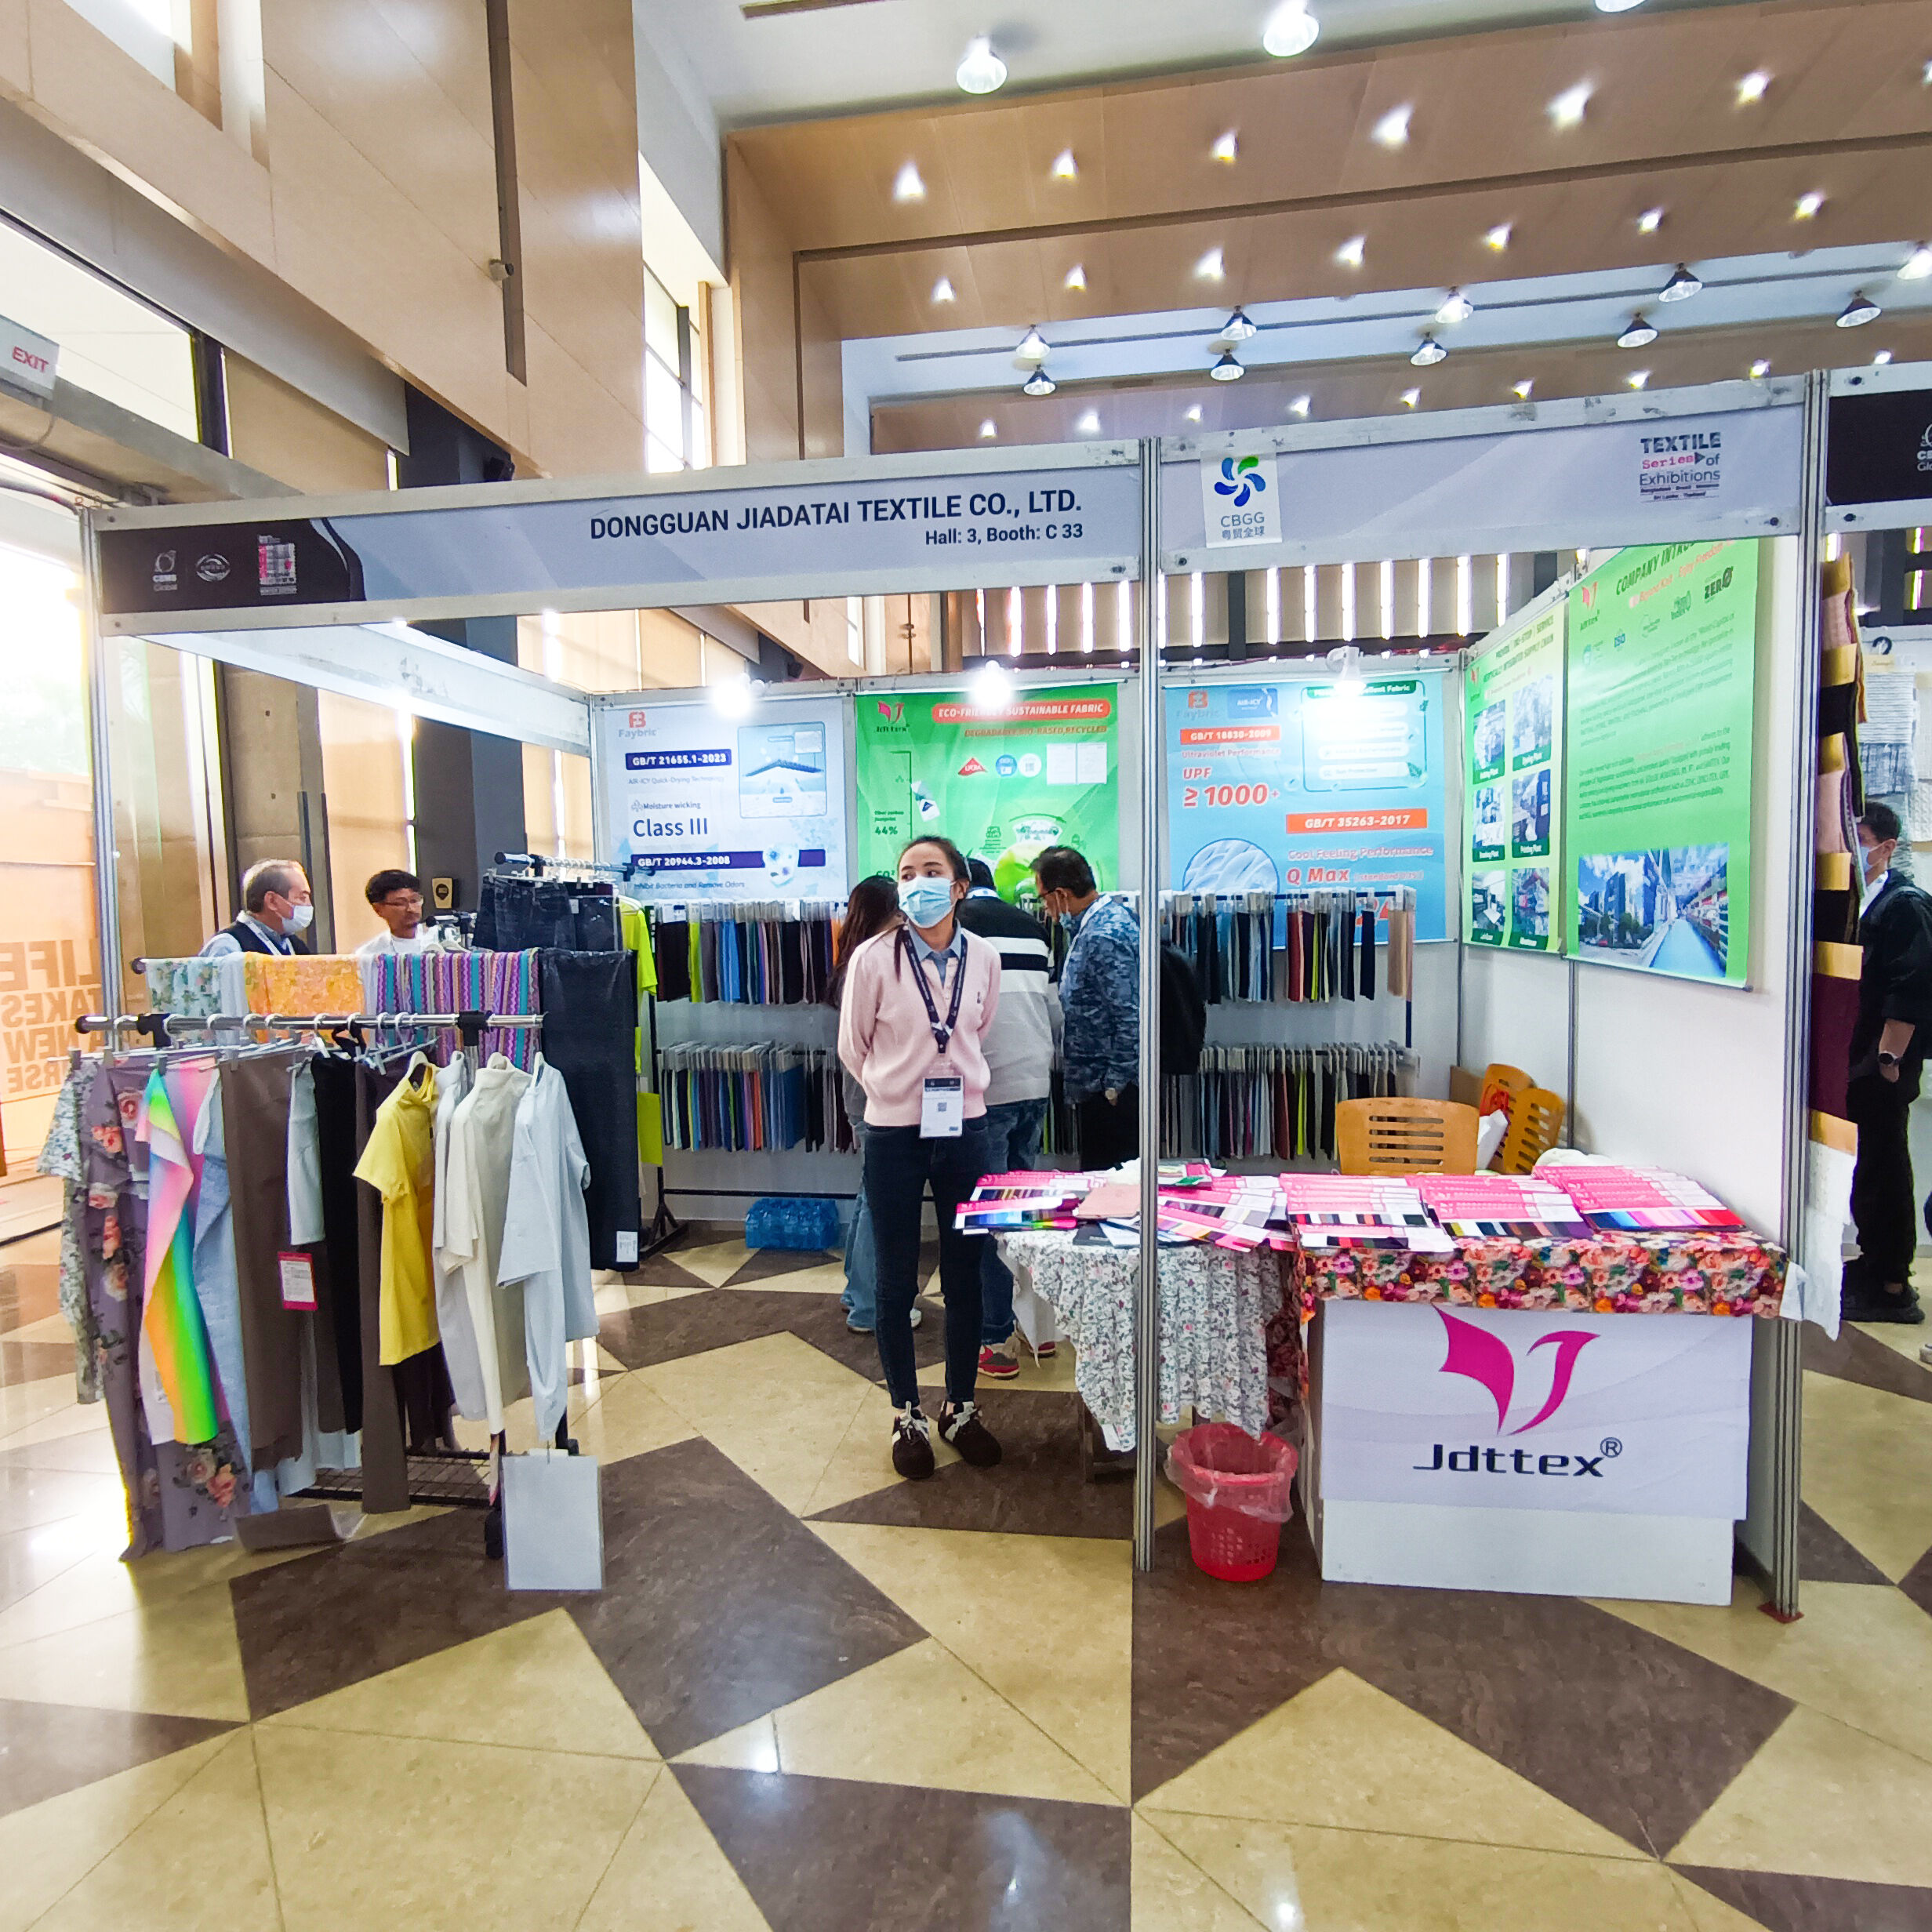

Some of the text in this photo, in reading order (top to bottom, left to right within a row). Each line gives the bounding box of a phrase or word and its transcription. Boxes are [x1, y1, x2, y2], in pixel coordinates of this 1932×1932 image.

[13, 347, 49, 372] EXIT
[1640, 432, 1721, 453] TEXTILE
[1643, 453, 1720, 469] Series of
[1640, 470, 1721, 485] Exhibitions
[591, 489, 1081, 539] DONGGUAN JIADATAI TEXTILE CO., LTD.
[1221, 511, 1265, 527] CBGG
[925, 523, 1083, 545] Hall: 3, Booth: C 33
[1616, 554, 1660, 595] COMPANY
[1007, 704, 1069, 716] SUSTAINABLE
[1070, 703, 1104, 714] FABRIC
[619, 728, 657, 739] Faybric
[1191, 732, 1214, 741] GB/T
[632, 756, 657, 766] GB/T
[1183, 768, 1211, 779] UPF
[633, 818, 684, 837] Class
[1305, 815, 1411, 829] GB/T 35263-2017
[1288, 845, 1434, 861] Cool Feeling Performance
[637, 858, 662, 866] GB/T
[1287, 868, 1301, 885] Q
[1307, 867, 1349, 883] Max
